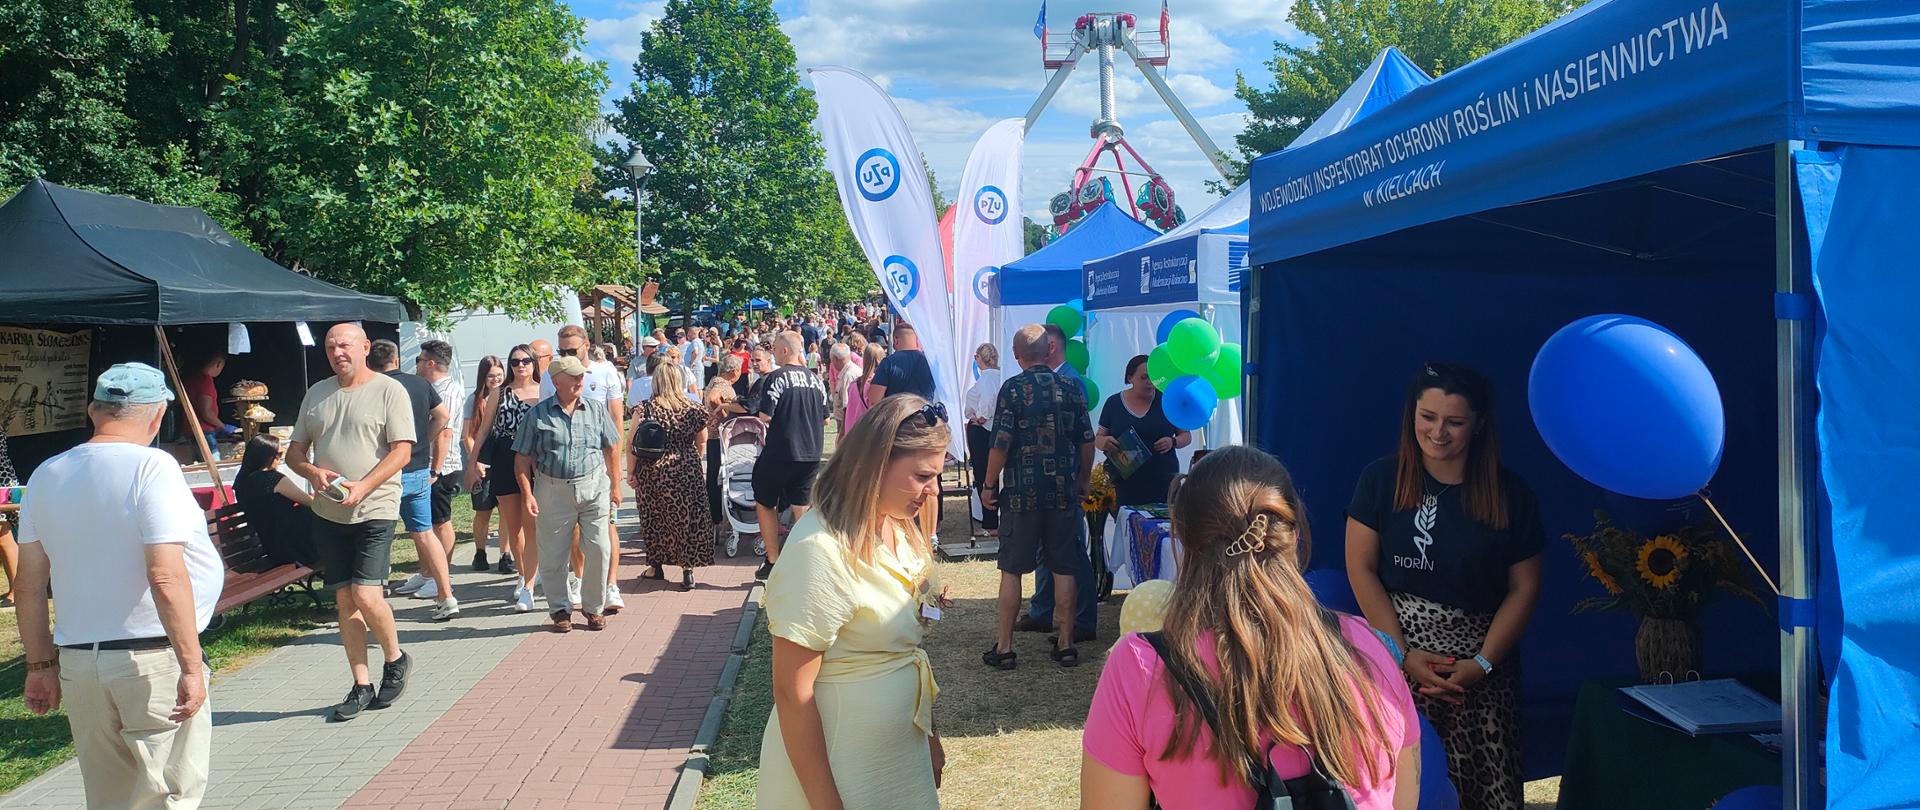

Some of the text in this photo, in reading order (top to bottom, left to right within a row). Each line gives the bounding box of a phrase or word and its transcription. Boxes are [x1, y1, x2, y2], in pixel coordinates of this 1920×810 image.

[1259, 2, 1728, 213] WOJEWÓDZKI INSPEKTORAT OCHRONY ROŚLIN i NASIENNICTWA
[1376, 160, 1446, 204] KIELCACH
[981, 197, 1001, 213] PZU
[1394, 555, 1434, 571] PIORIN
